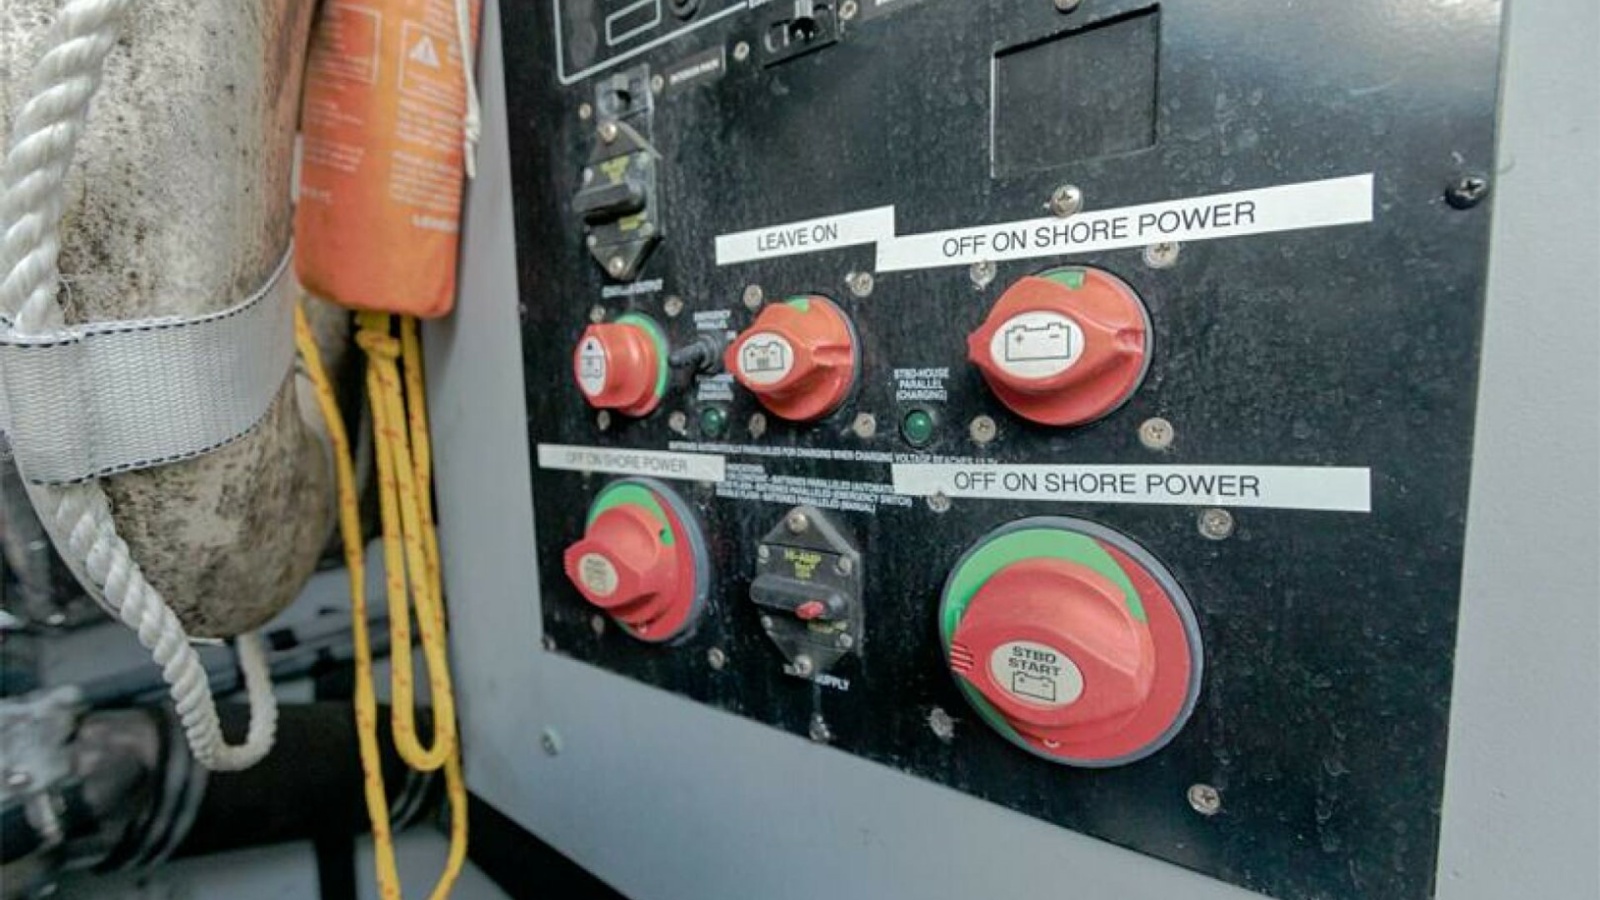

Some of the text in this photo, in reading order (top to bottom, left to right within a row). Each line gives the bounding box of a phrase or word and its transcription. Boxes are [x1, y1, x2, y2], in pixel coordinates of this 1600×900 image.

[758, 221, 838, 252] LEAVE ON
[942, 200, 1256, 258] OFF ON SHORE POWER
[899, 379, 944, 390] PARALLEL
[896, 389, 948, 402] (CHARGING)
[643, 455, 688, 474] POWER
[953, 471, 1260, 497] OFF ON SHORE POWER
[1012, 646, 1056, 664] STBD
[1008, 657, 1061, 676] START
